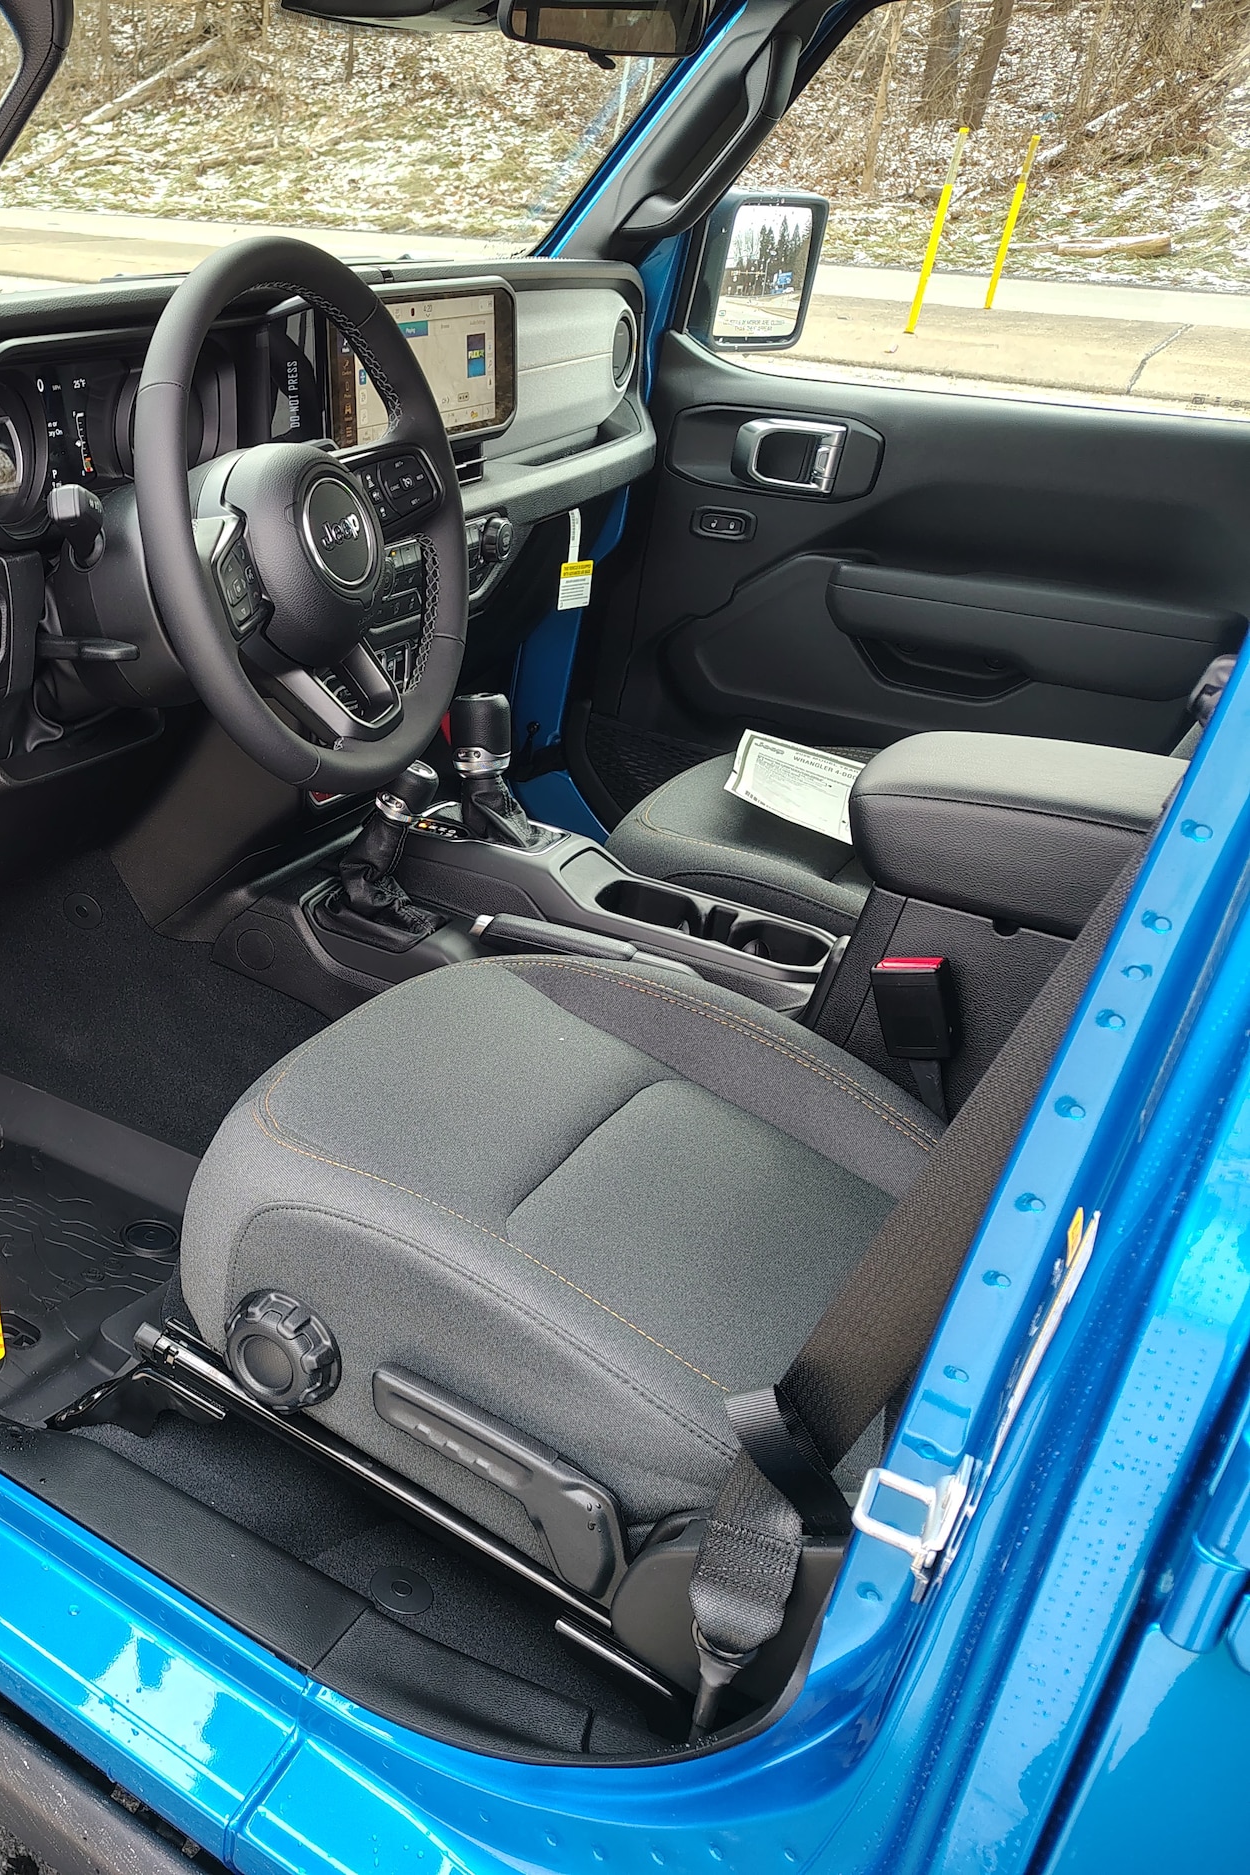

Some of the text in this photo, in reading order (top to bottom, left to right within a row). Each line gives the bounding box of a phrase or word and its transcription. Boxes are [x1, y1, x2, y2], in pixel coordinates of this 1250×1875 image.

[36, 378, 44, 393] 0
[286, 360, 301, 429] DO NOT PRESS
[322, 513, 360, 551] Jeep
[793, 755, 833, 773] WRANGLER
